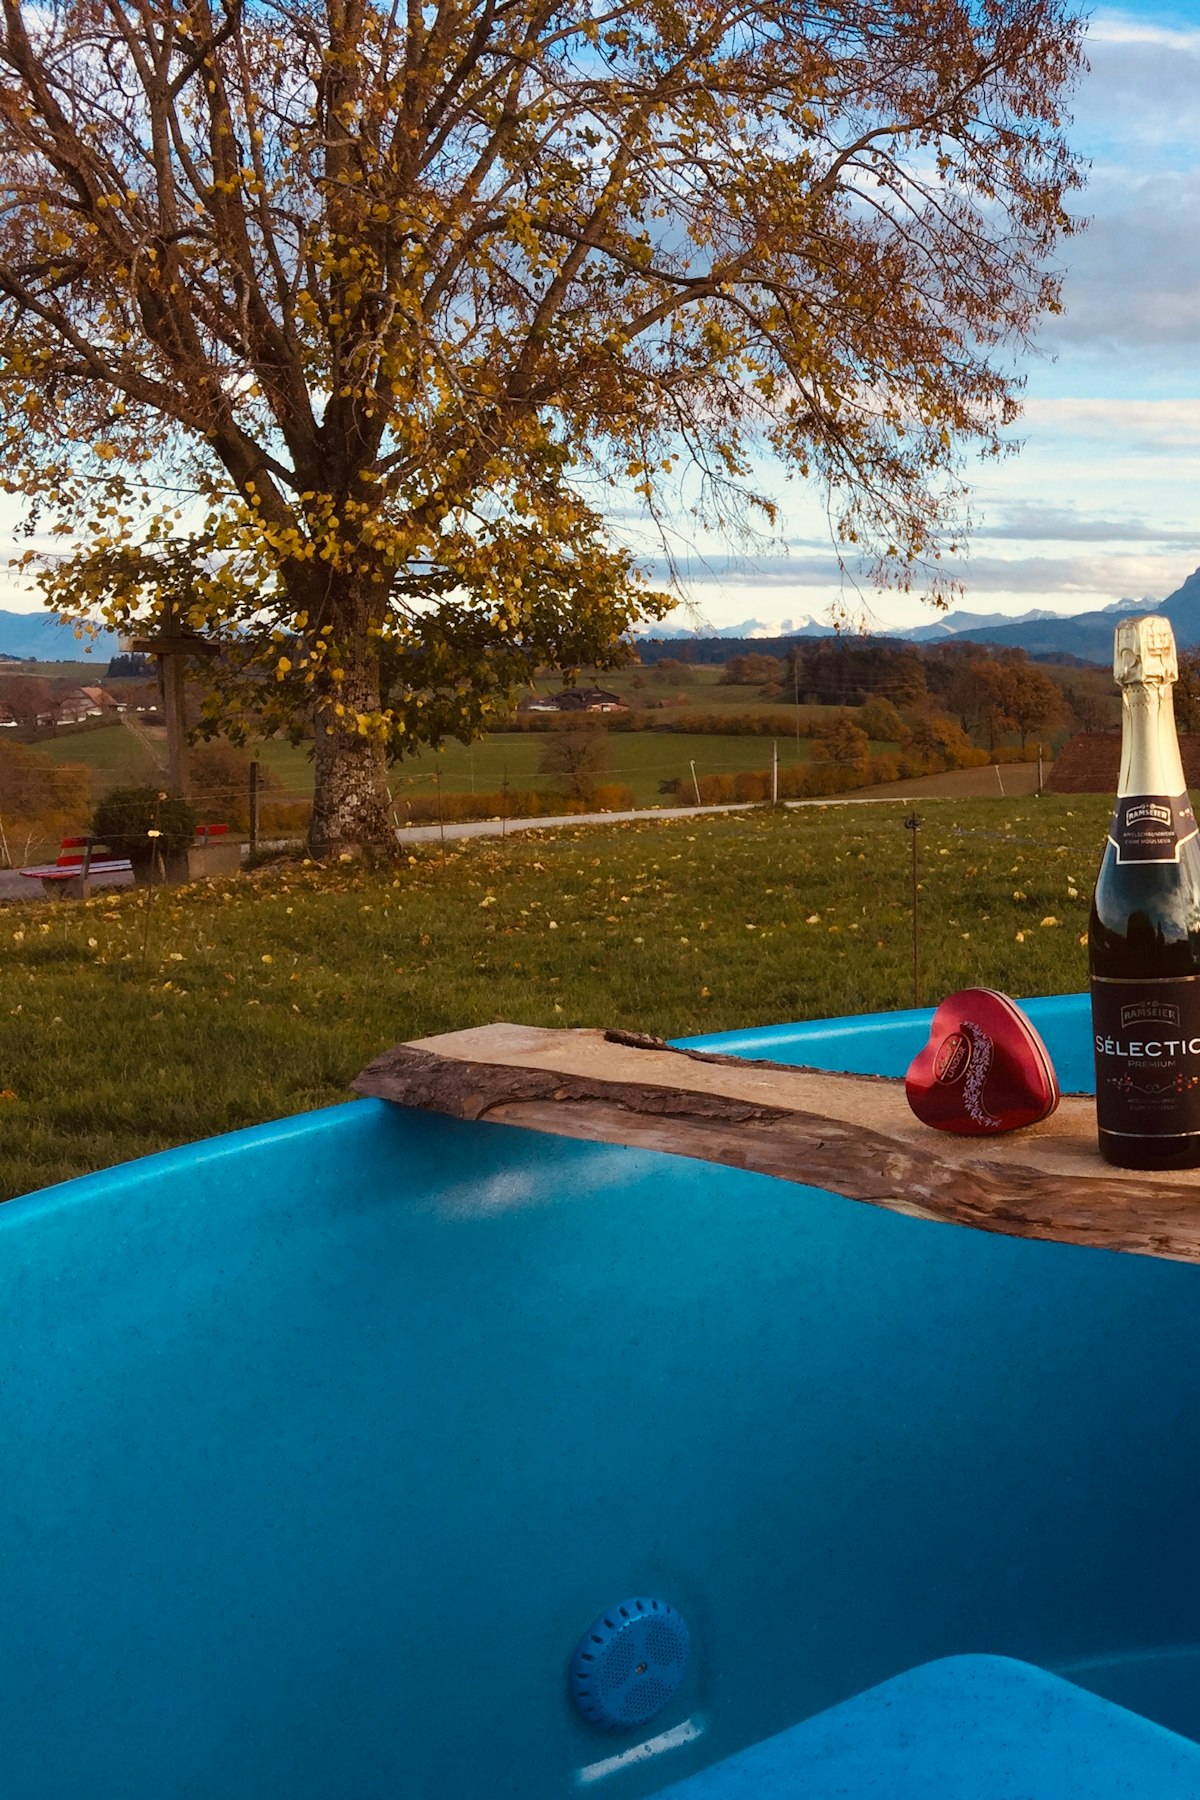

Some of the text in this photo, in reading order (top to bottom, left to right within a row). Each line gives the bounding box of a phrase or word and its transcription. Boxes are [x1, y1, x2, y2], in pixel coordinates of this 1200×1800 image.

[1128, 809, 1168, 820] RAMSEIER
[1123, 1007, 1176, 1020] RAMSEIER
[1127, 1059, 1176, 1068] PREMIUM
